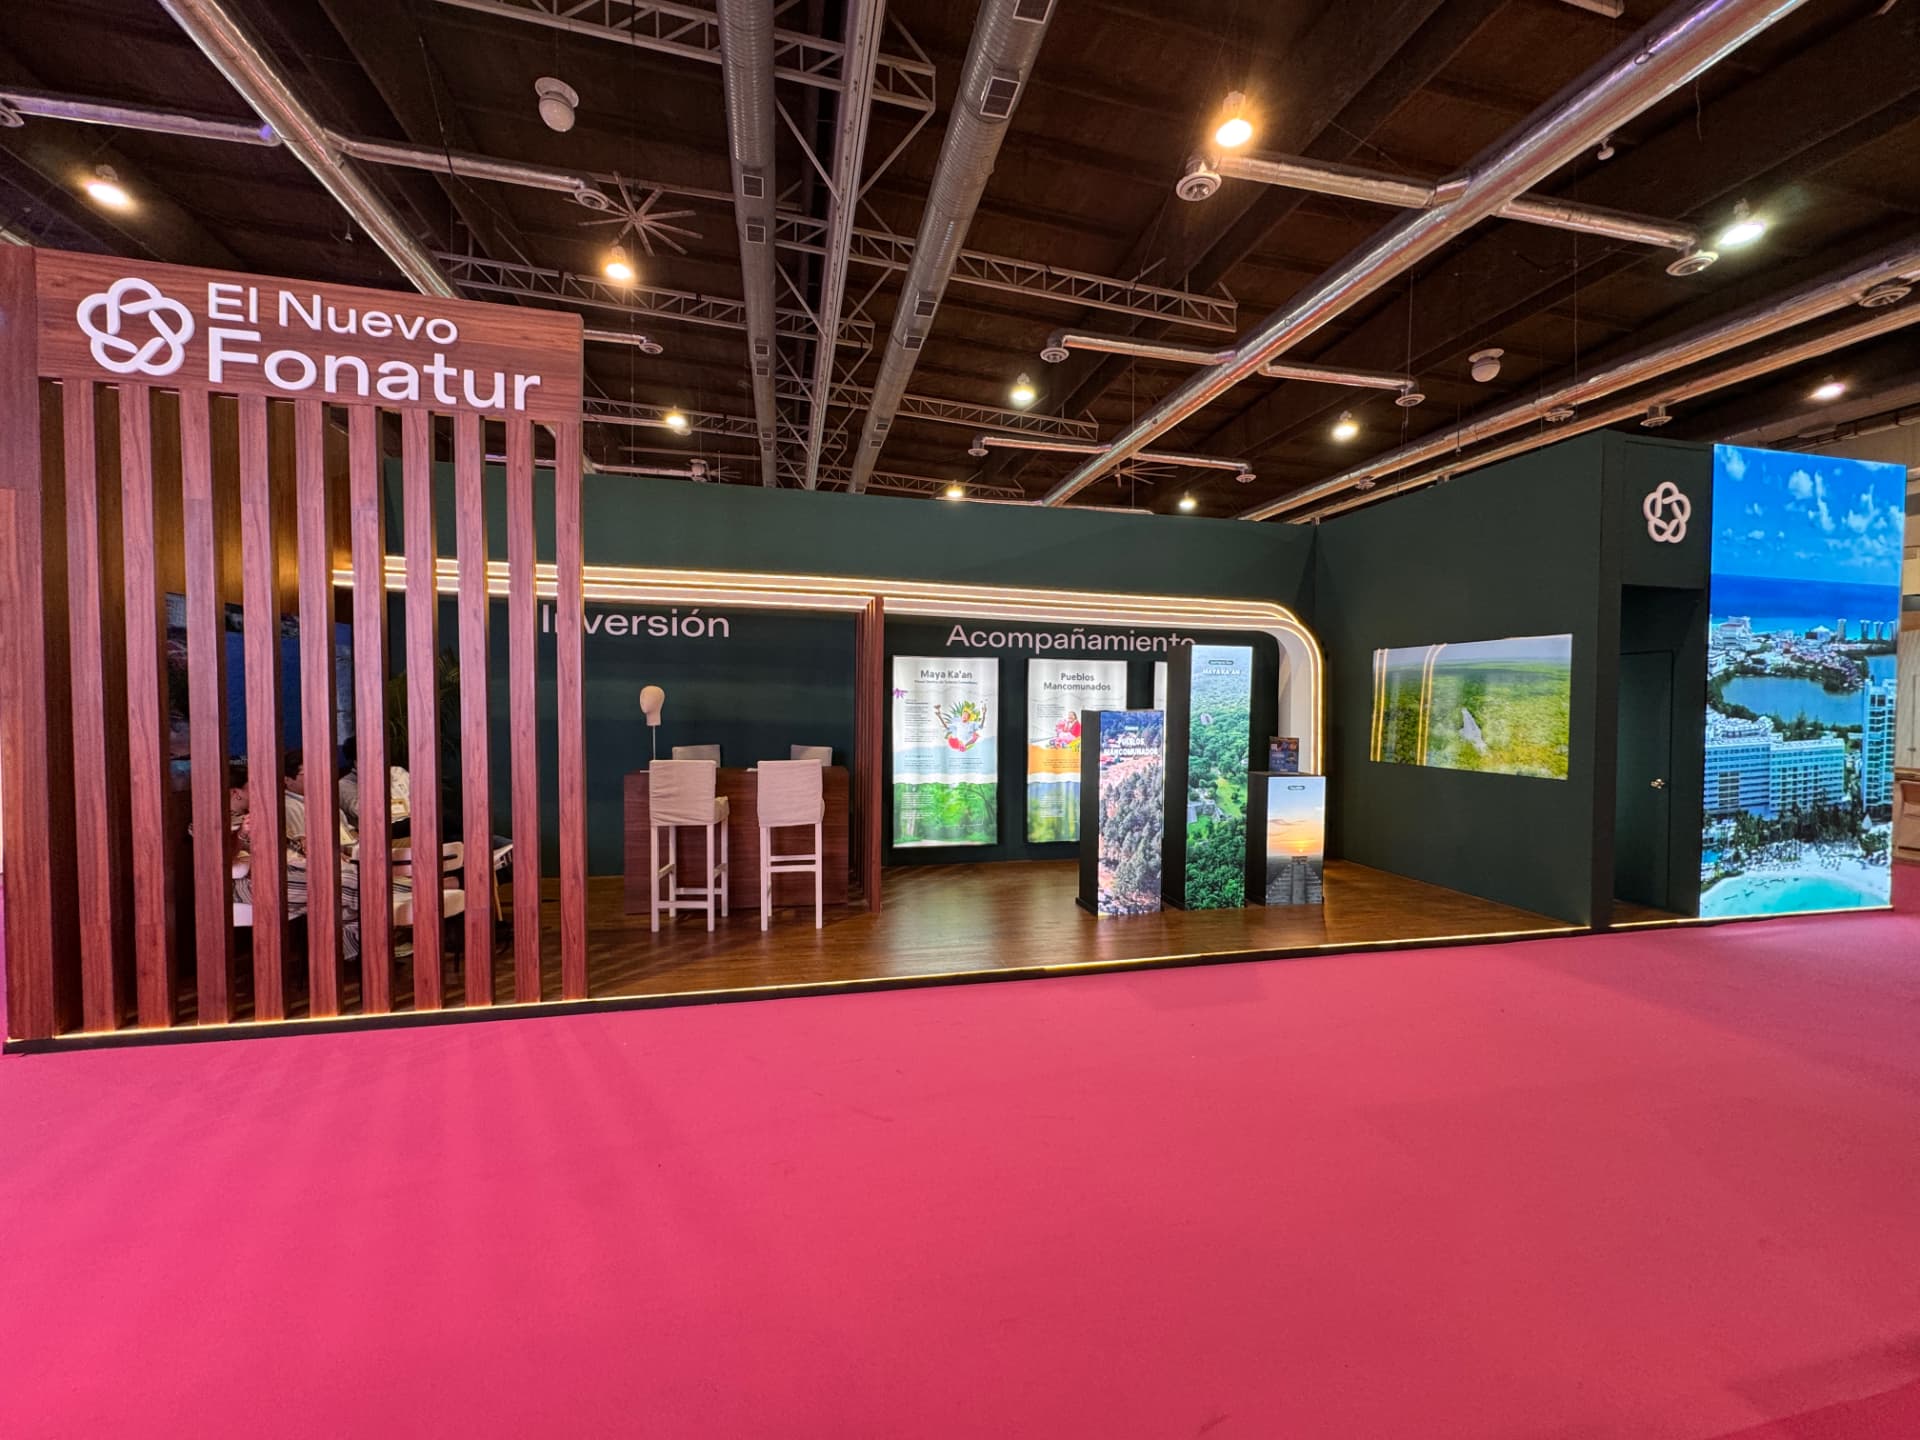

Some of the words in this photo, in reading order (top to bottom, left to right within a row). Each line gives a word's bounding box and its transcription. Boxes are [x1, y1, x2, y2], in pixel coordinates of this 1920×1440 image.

[208, 282, 258, 324] El
[279, 290, 459, 345] Nuevo
[208, 326, 541, 411] Fonatur
[542, 604, 730, 638] Iversión
[920, 669, 946, 680] Maya
[947, 669, 973, 679] Ka'an
[1060, 672, 1095, 681] Pueblos
[1043, 682, 1111, 691] Mancomunados
